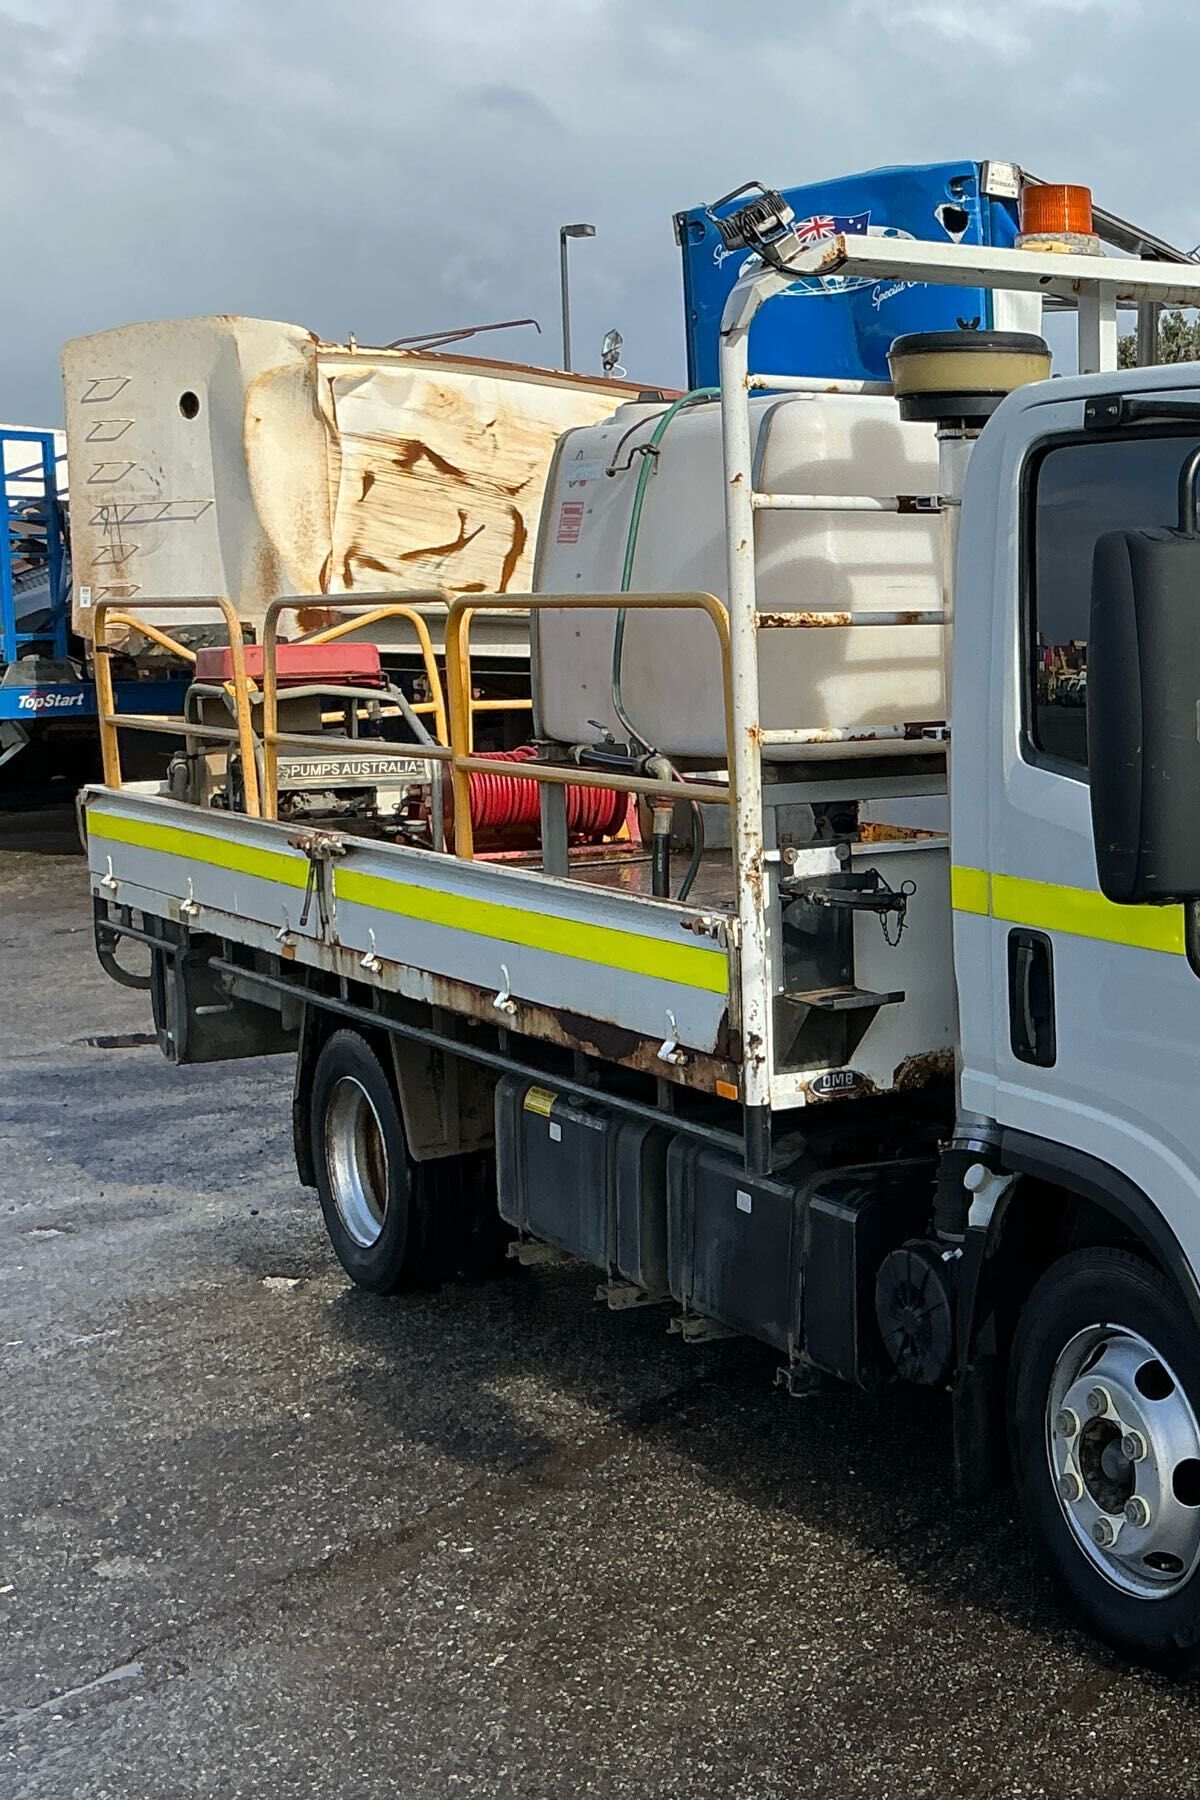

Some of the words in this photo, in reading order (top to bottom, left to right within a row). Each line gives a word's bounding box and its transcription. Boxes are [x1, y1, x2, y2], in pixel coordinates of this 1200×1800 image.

[18, 693, 84, 711] TopStart
[290, 763, 340, 776] PUMPS
[342, 761, 417, 774] AUSTRALIA
